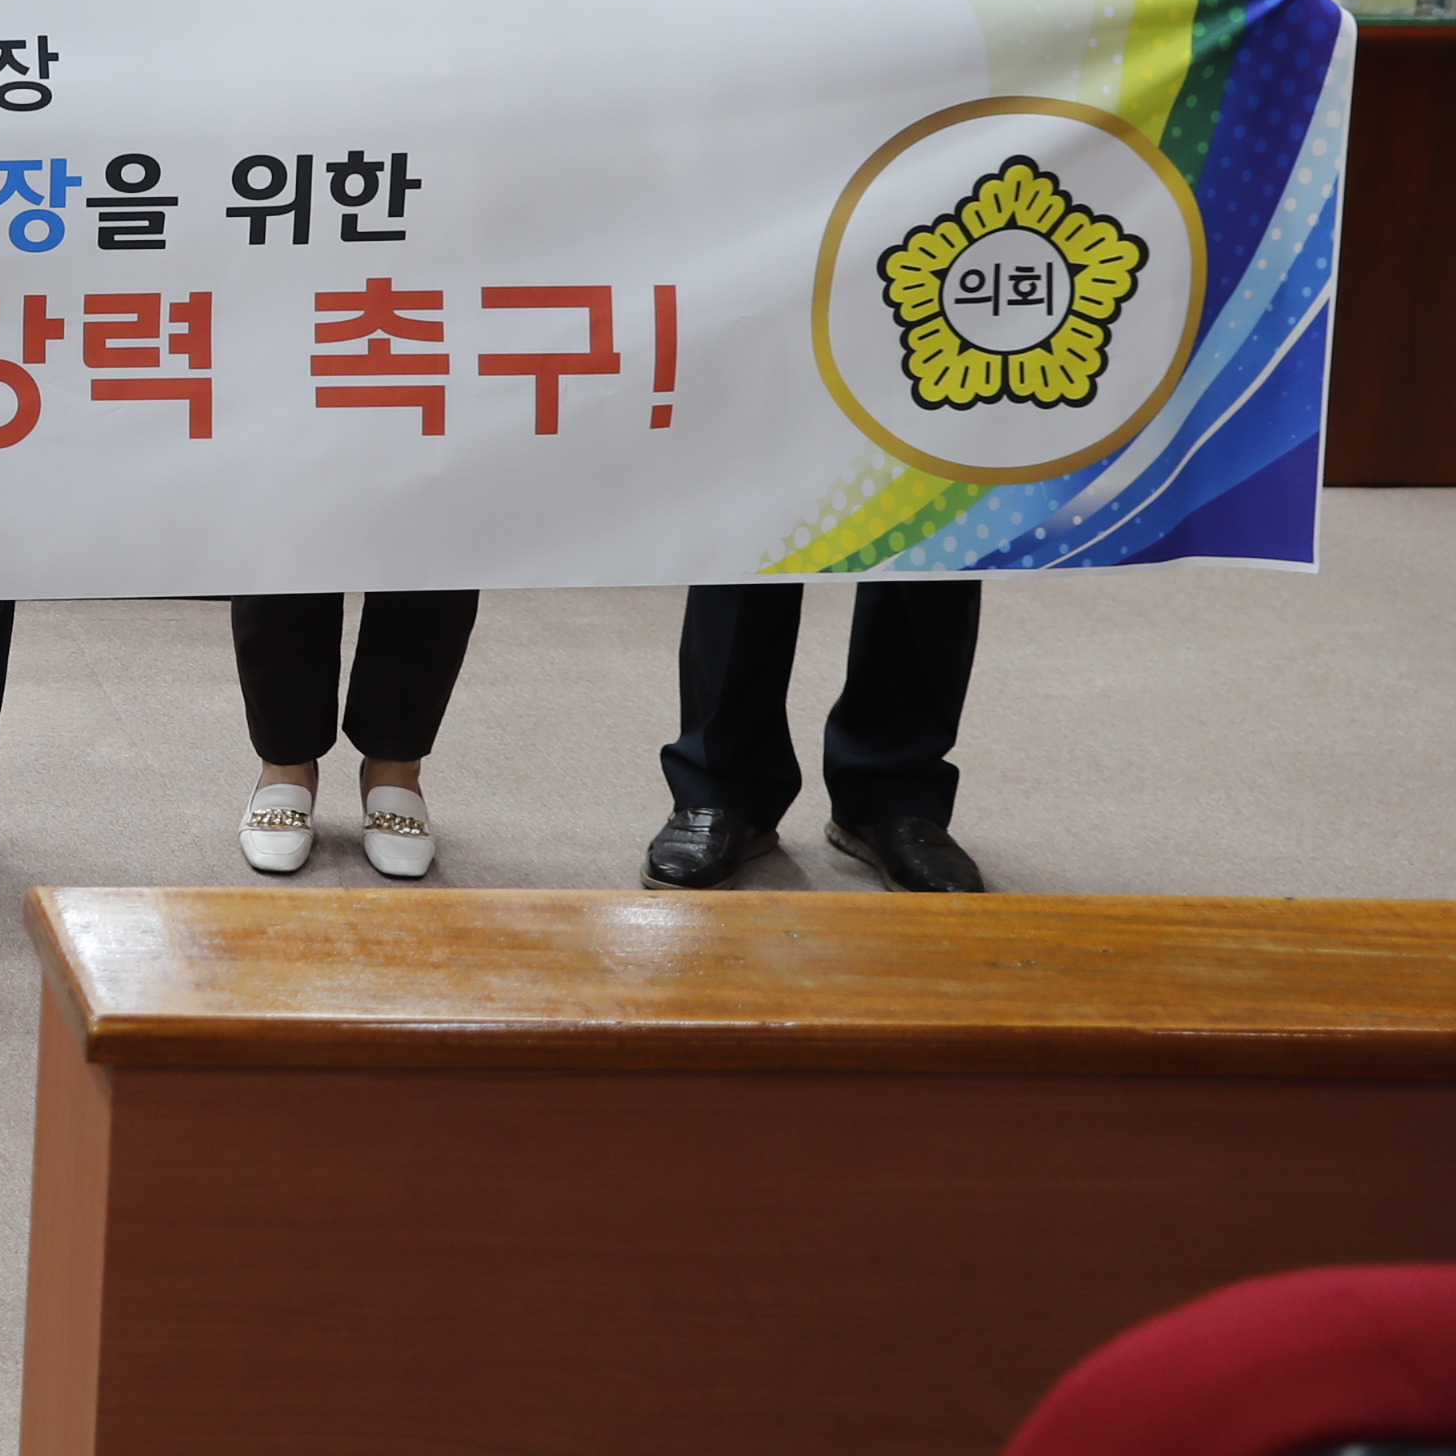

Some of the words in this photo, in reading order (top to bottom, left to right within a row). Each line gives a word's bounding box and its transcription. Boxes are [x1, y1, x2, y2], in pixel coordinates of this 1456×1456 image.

[226, 151, 421, 245] 위한
[954, 262, 1054, 317] 의회
[311, 278, 676, 435] 촉구!
